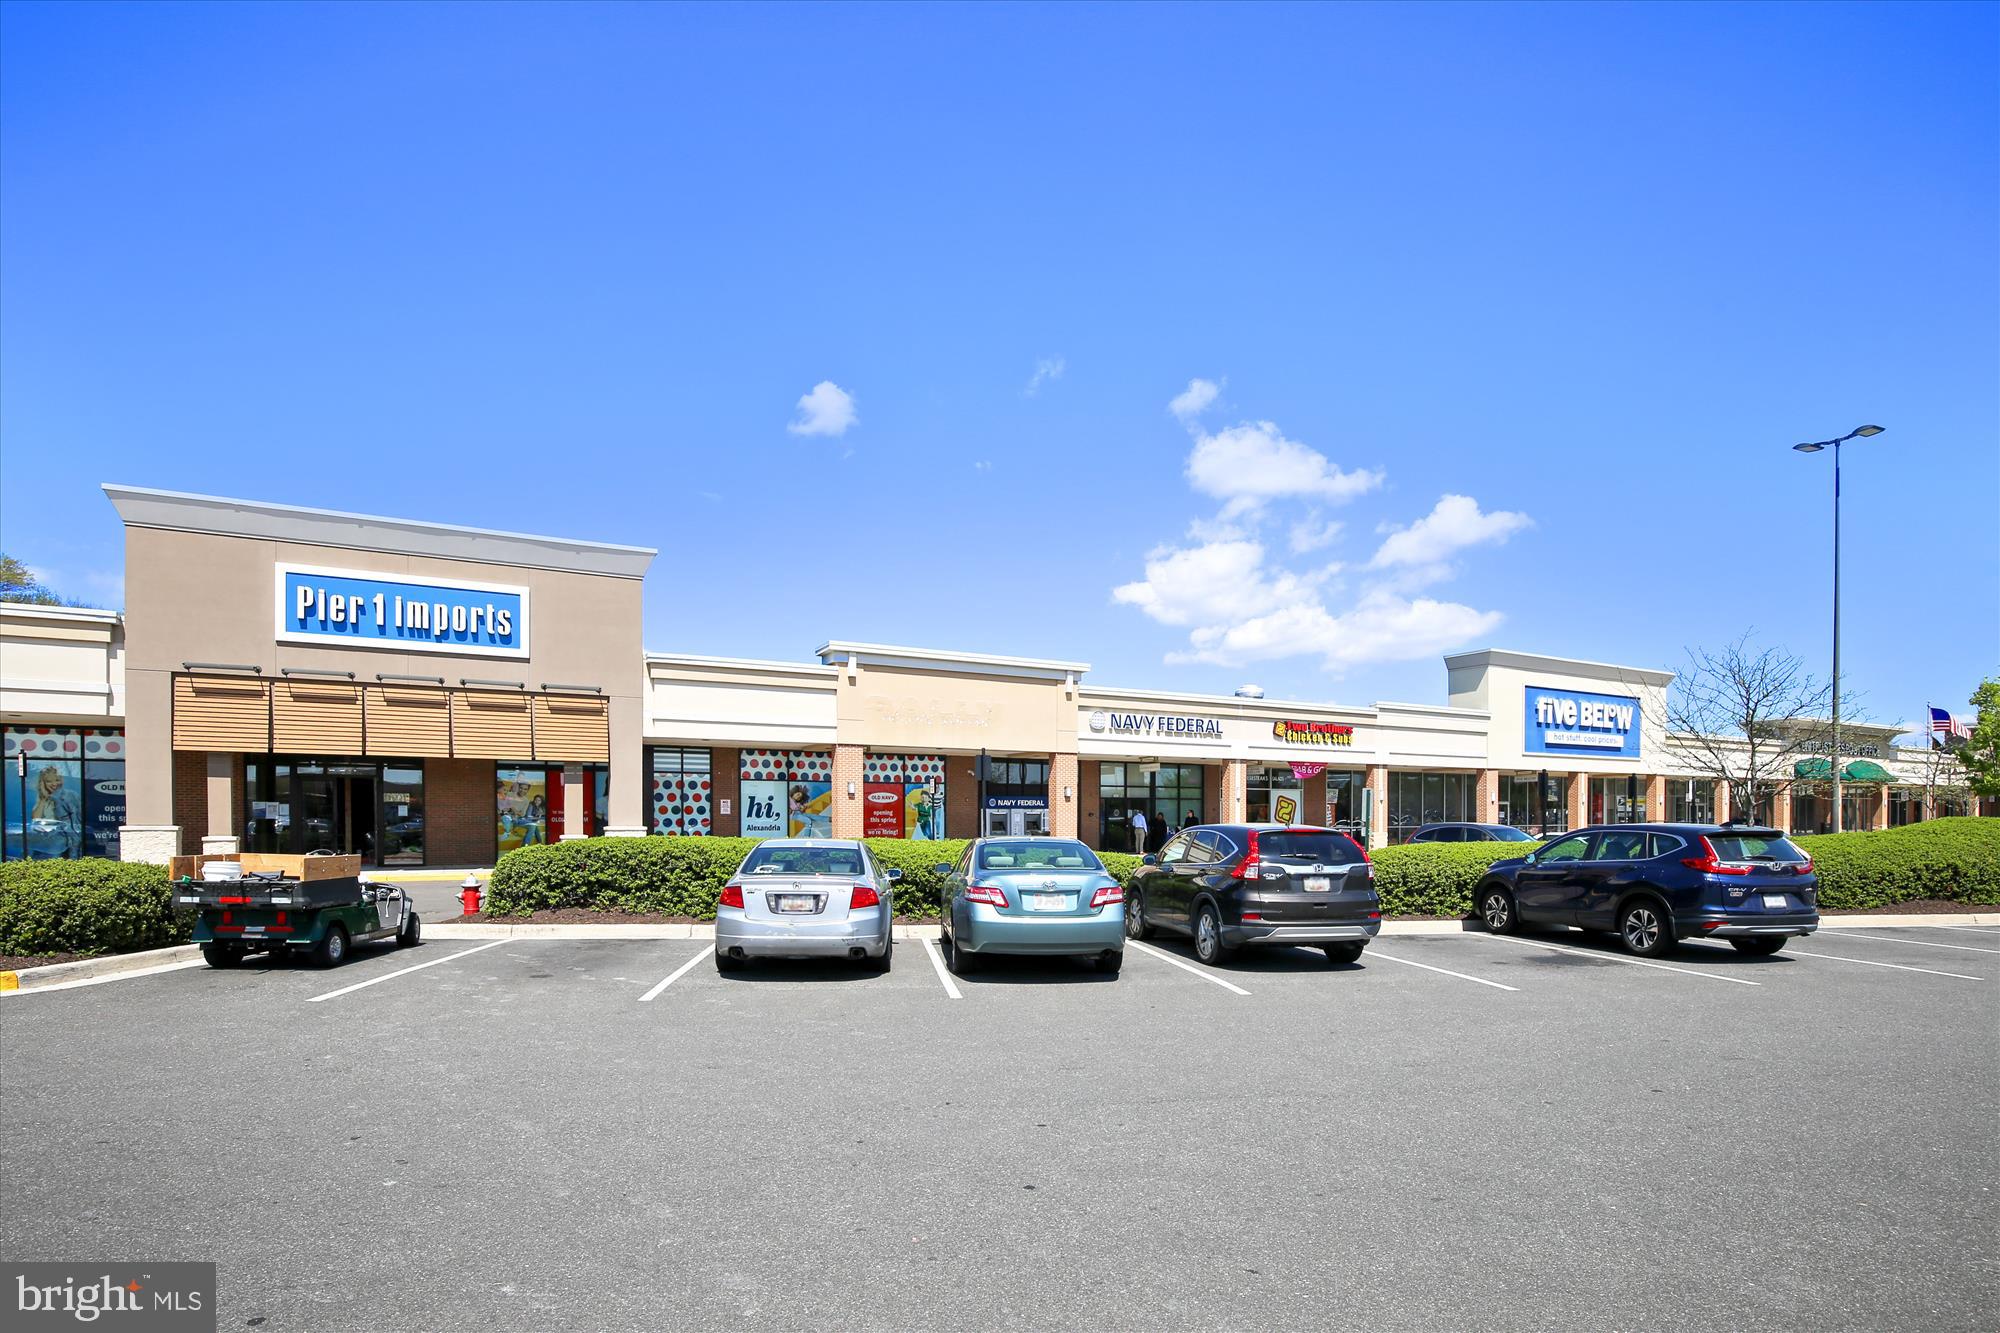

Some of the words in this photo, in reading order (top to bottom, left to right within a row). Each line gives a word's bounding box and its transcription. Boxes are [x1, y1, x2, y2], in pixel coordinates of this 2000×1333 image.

[297, 585, 364, 624] Pier
[372, 593, 384, 626] 1
[395, 596, 512, 636] imports
[1535, 696, 1578, 726] five
[1579, 700, 1633, 730] BELOW
[1110, 713, 1155, 731] NAVY
[1158, 716, 1223, 734] FEDERAL
[1286, 720, 1308, 732] Two
[1309, 722, 1354, 735] Brothers
[1286, 730, 1324, 742] Chicken
[1332, 733, 1353, 744] Subs
[746, 795, 781, 821] hi,
[98, 814, 116, 822] this
[94, 831, 118, 839] we're
[746, 824, 781, 832] Alexandria
